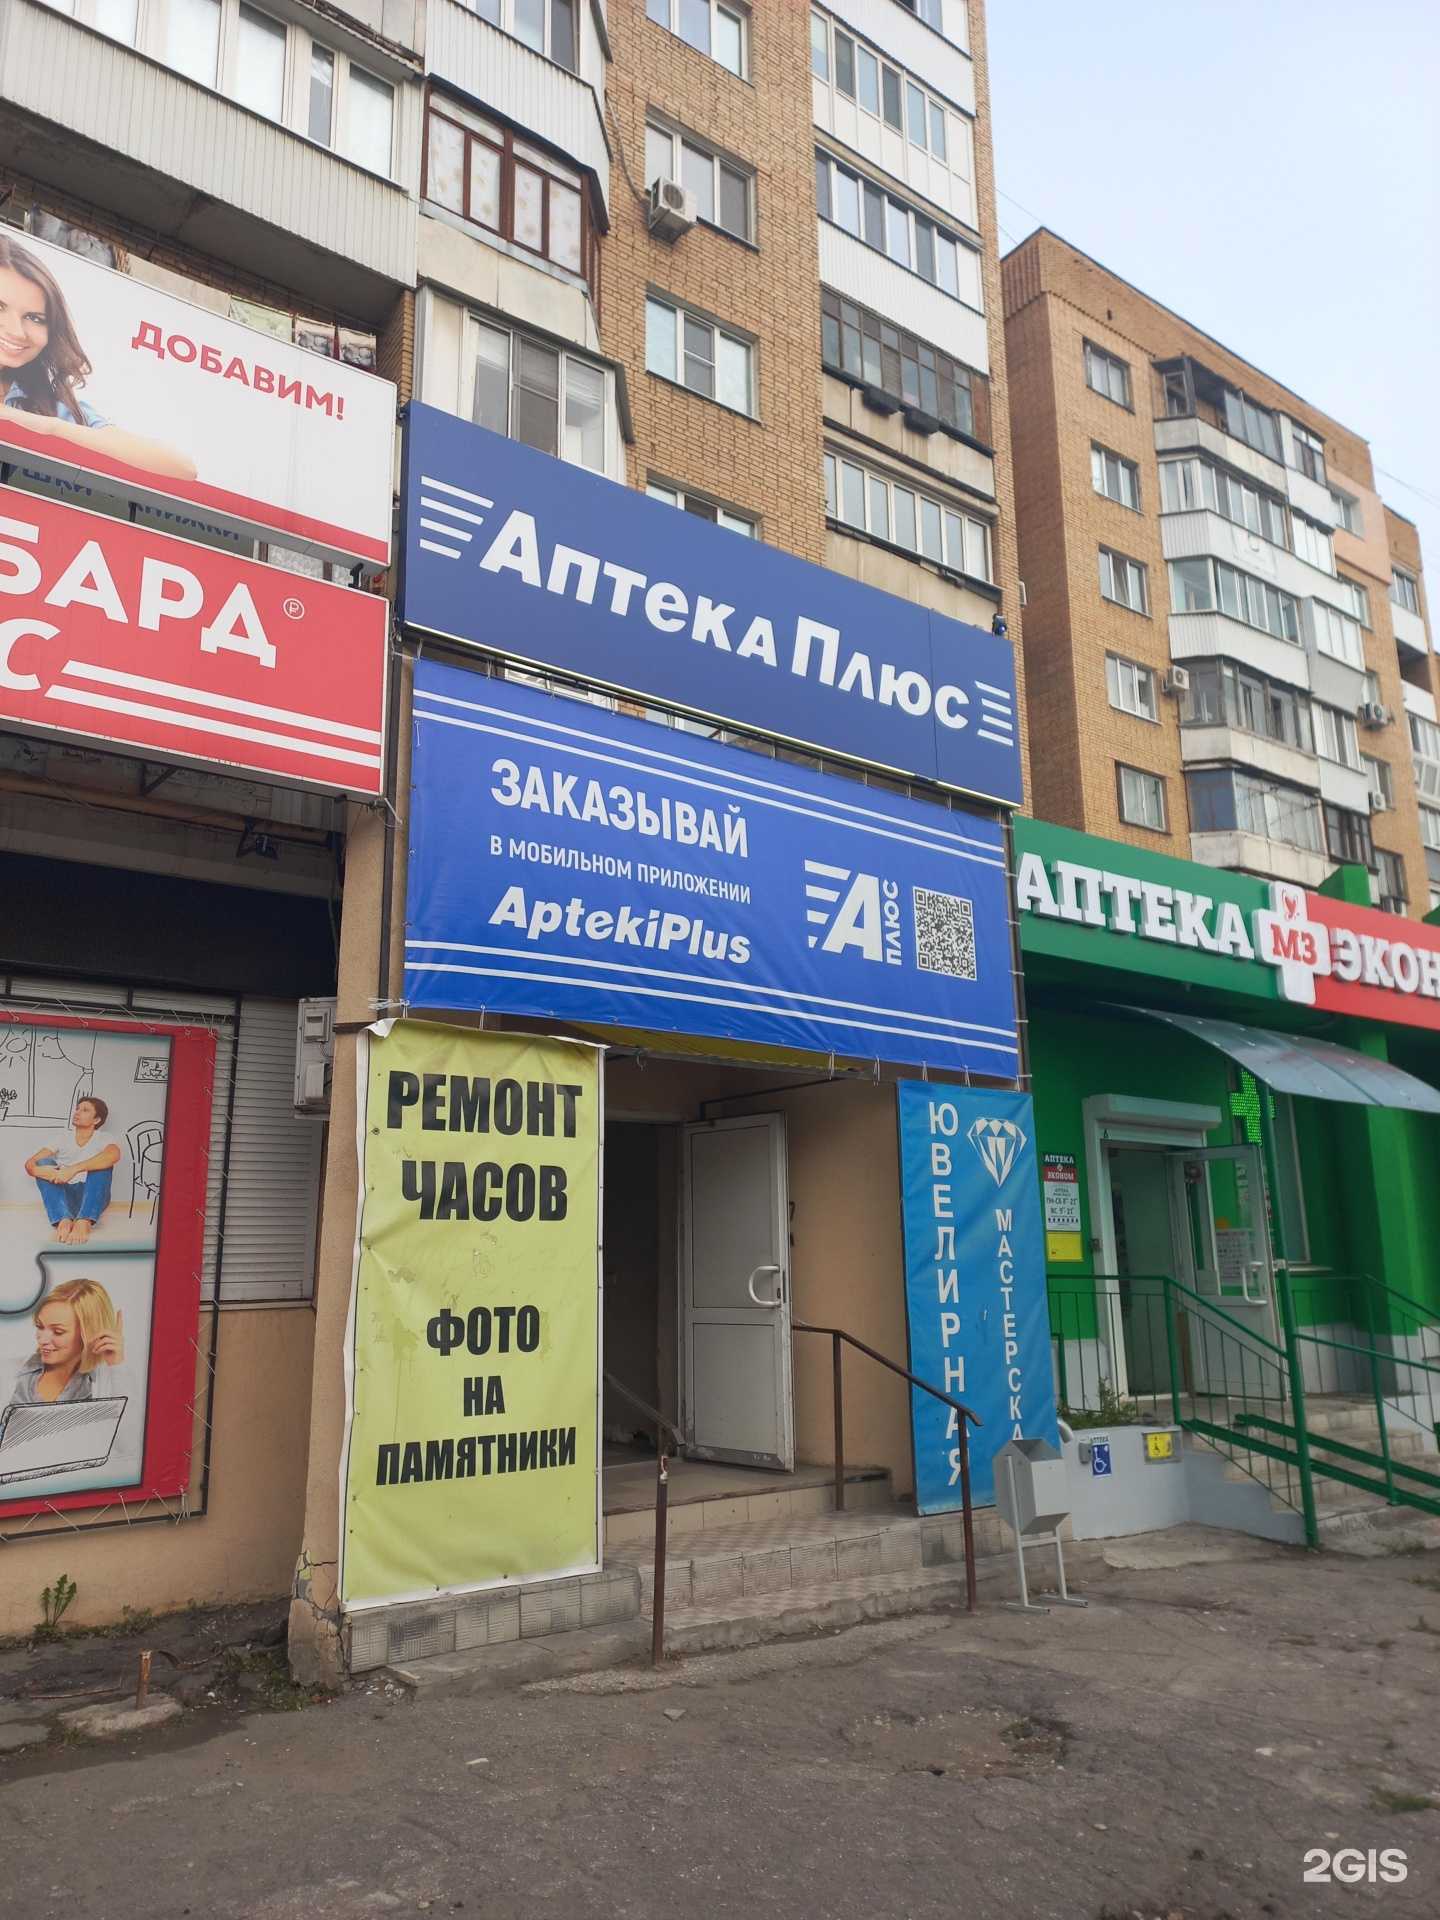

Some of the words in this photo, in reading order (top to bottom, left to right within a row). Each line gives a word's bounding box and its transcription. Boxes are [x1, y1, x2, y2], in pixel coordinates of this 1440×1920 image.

[131, 320, 346, 421] ДОБАВИМ!
[791, 615, 969, 730] Плюс
[490, 758, 749, 858] ЗАКАЗЫВАЙ
[490, 835, 503, 856] В
[509, 838, 632, 880] МОБИЛЬНОМ
[637, 863, 751, 905] ПРИЛОЖЕНИИ
[1016, 851, 1254, 959] АПТЕКА
[488, 886, 751, 964] AptekiPlus
[882, 879, 902, 966] ПЛЮС
[386, 1070, 583, 1138] РЕМОНТ
[401, 1160, 568, 1221] ЧАСОВ
[426, 1304, 540, 1357] ФОТО
[463, 1375, 506, 1417] НА
[375, 1427, 577, 1486] ПАМЯТНИКИ
